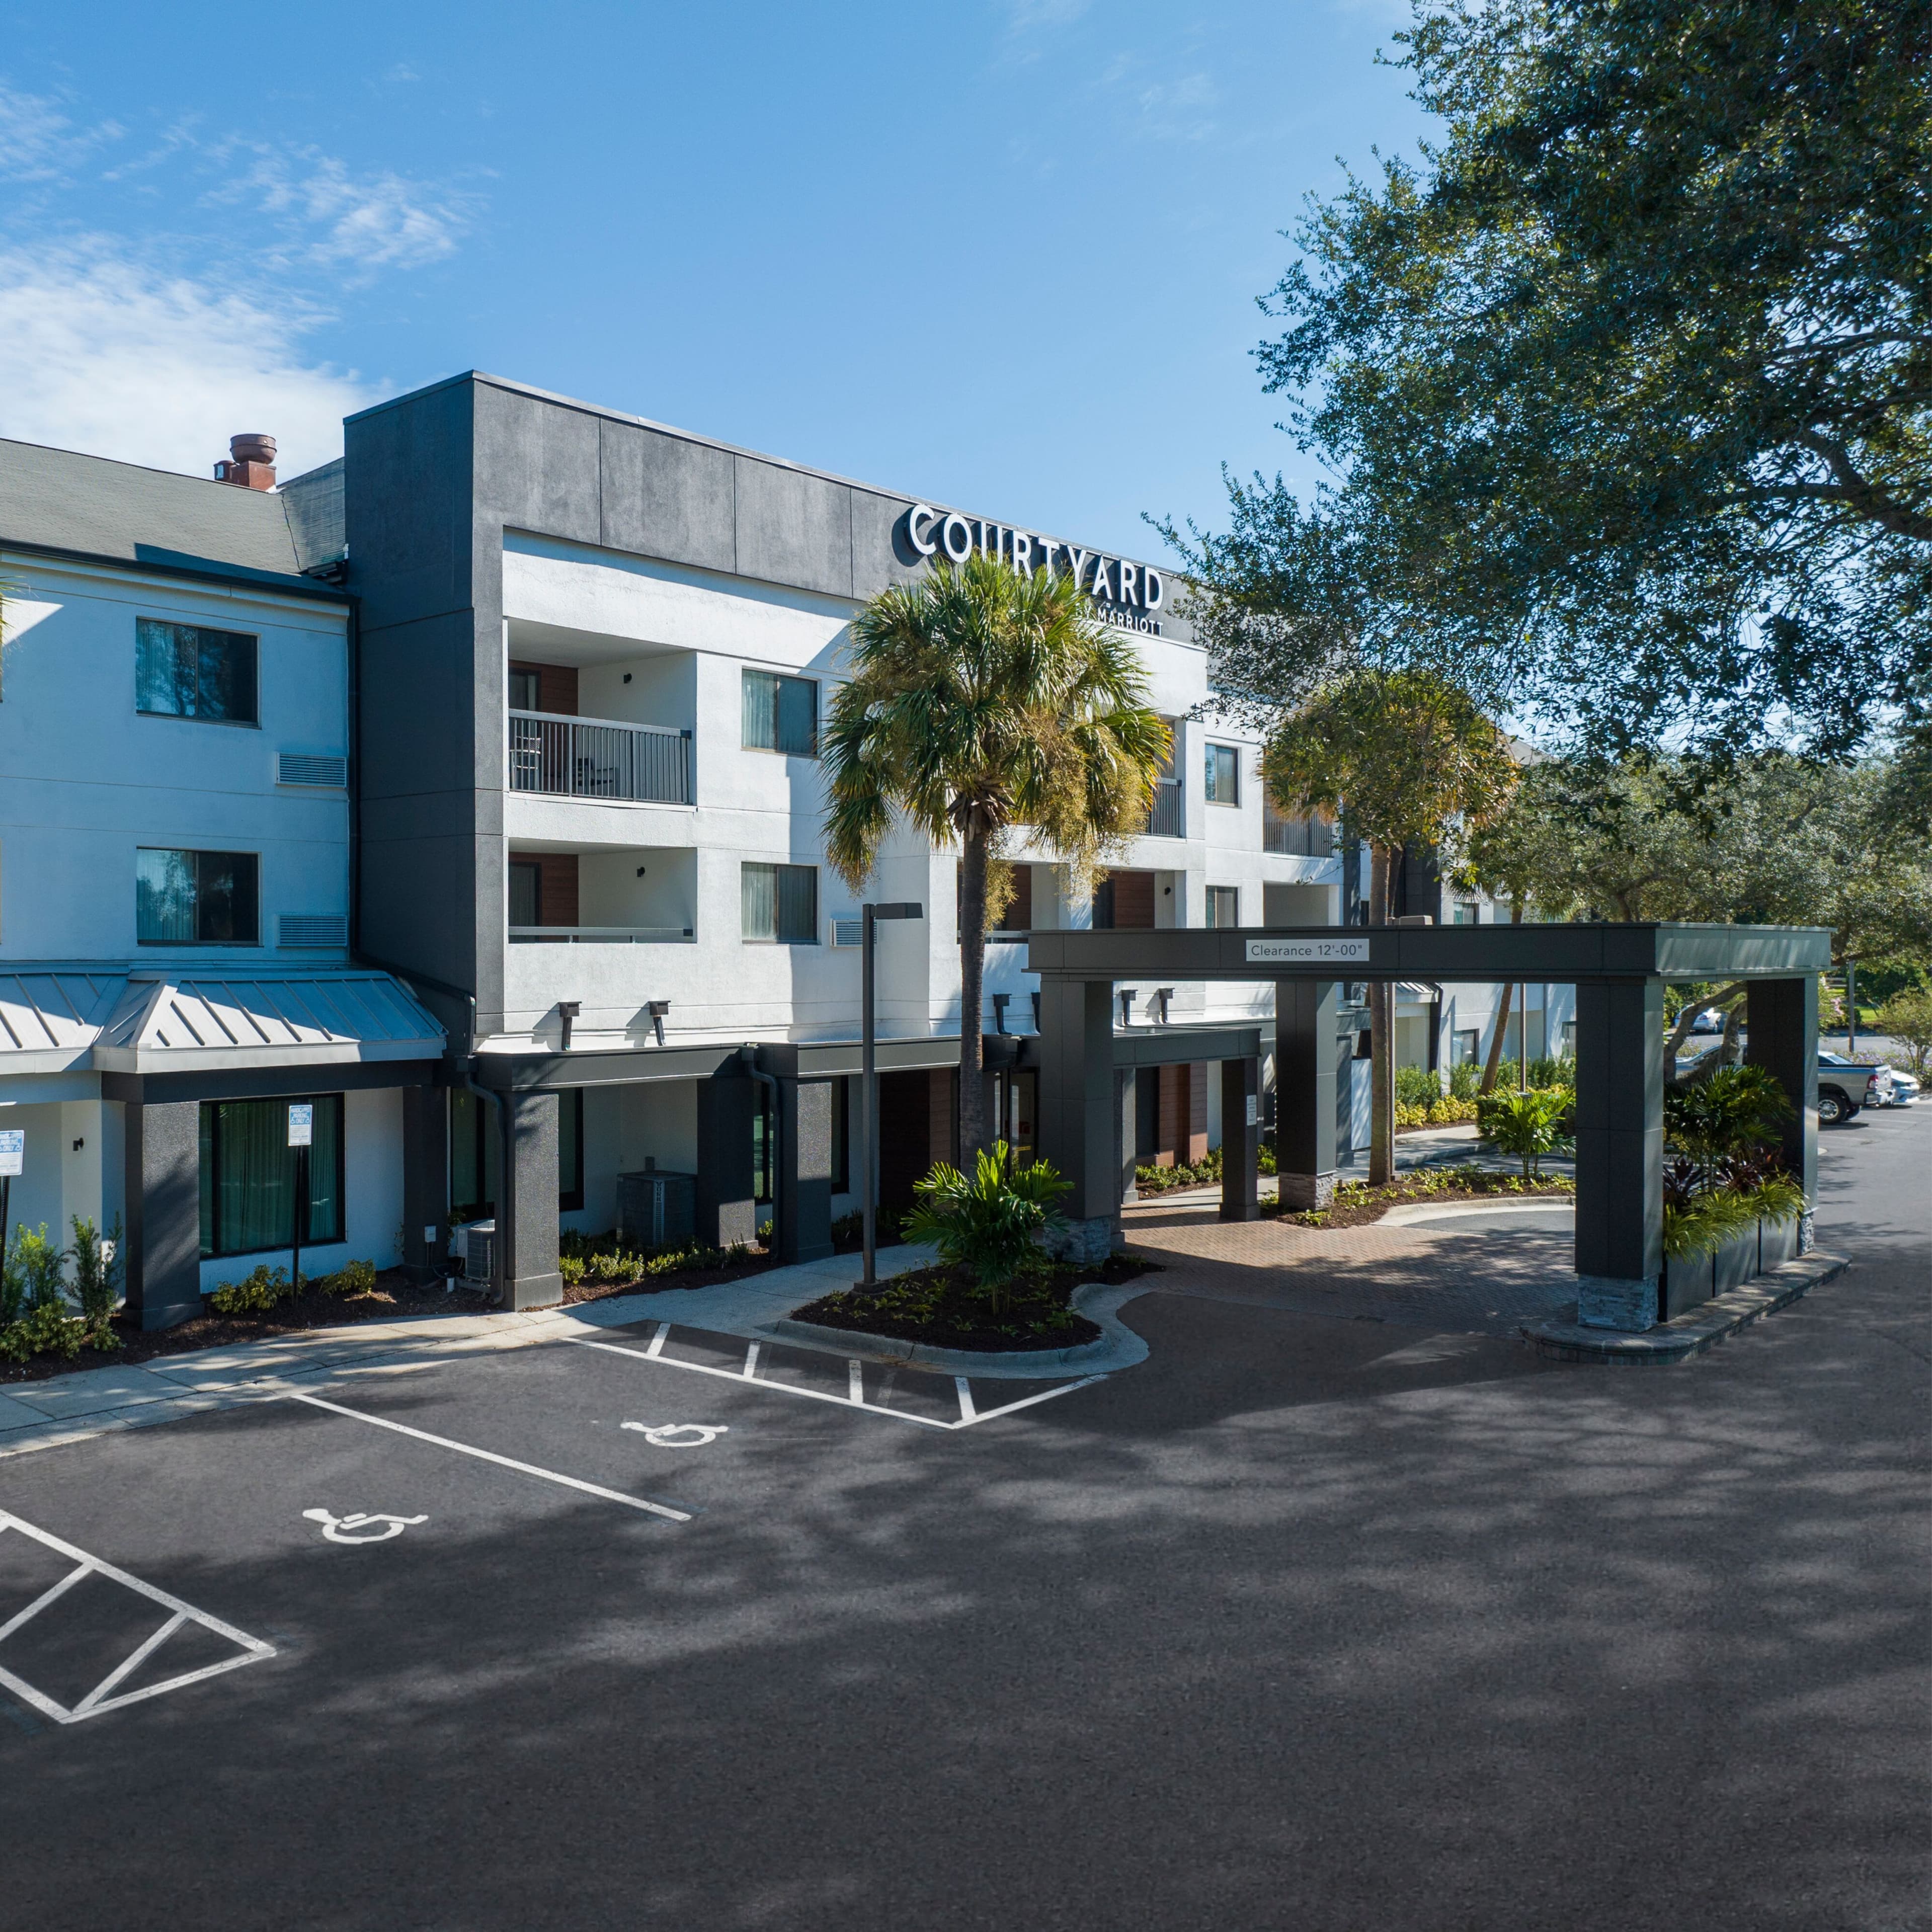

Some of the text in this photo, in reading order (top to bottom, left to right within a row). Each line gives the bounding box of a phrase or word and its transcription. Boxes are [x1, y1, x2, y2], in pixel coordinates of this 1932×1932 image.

[909, 504, 1164, 610] COURTYARD
[1098, 607, 1163, 636] MARRIOTT
[1251, 944, 1362, 956] Clearance 12'-00"
